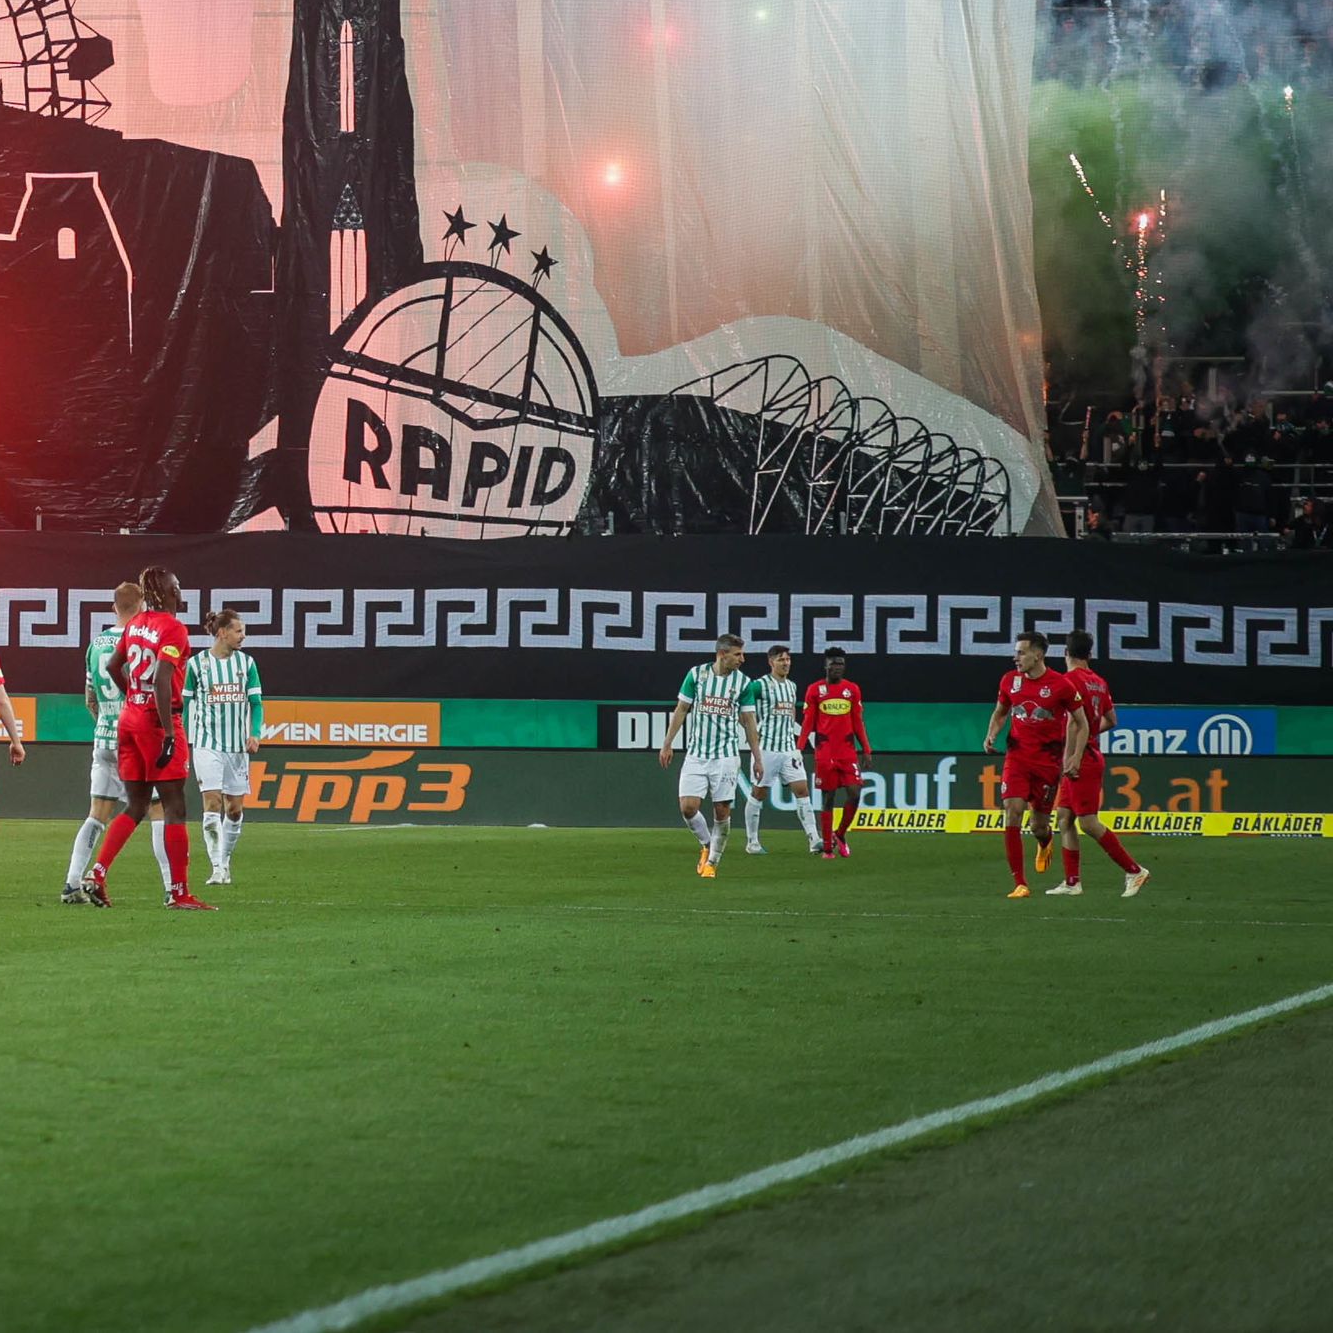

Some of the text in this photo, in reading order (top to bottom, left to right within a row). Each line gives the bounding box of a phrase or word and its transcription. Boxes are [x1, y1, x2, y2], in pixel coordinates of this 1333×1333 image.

[343, 398, 576, 508] RAPID
[127, 644, 157, 692] 22
[207, 693, 245, 702] ENERGIE
[213, 684, 240, 693] WIEN
[705, 696, 729, 707] WIEN
[260, 722, 428, 743] WIEN ENERGIE
[243, 751, 472, 824] tipp3
[859, 756, 957, 811] auf
